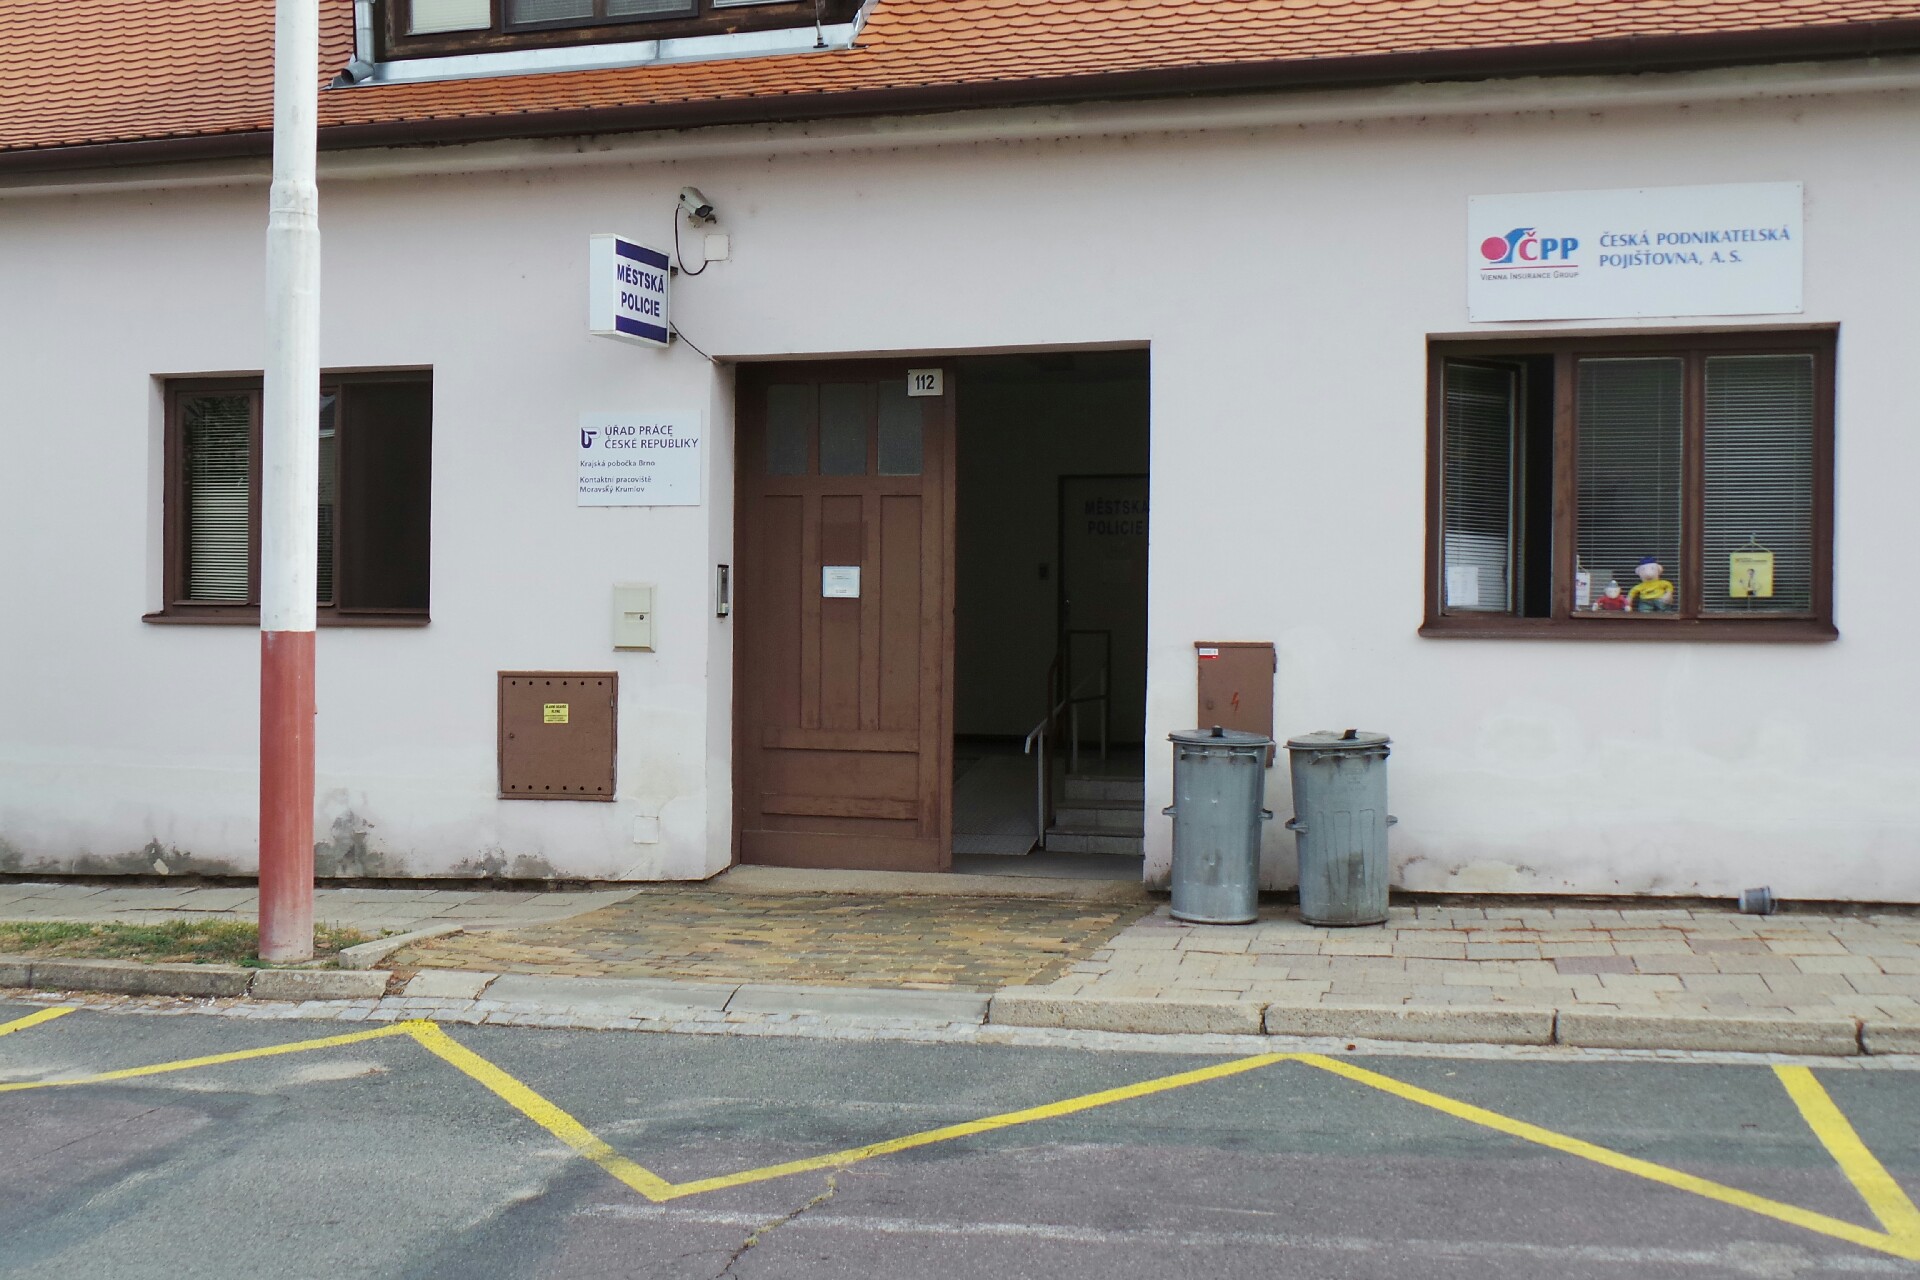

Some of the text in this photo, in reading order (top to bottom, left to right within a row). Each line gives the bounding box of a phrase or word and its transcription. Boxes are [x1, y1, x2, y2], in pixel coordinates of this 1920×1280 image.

[1599, 224, 1790, 247] ČESKÁ PODNIKATELSKÁ
[1518, 231, 1579, 261] ČPP
[1599, 249, 1742, 269] POJIŠŤOVNA, A. S.
[617, 264, 664, 294] MĚSTSKÁ
[621, 291, 660, 317] POLICIE
[916, 374, 934, 390] 112
[604, 424, 673, 436] ÚŘAD PRÁCE
[604, 436, 699, 449] ČESKÉ REPUBLIKY
[580, 460, 605, 468] Krajská
[607, 459, 637, 468] pobočka
[615, 475, 652, 484] pracoviště
[579, 485, 613, 494] Moravský
[1088, 520, 1143, 535] POLICIE
